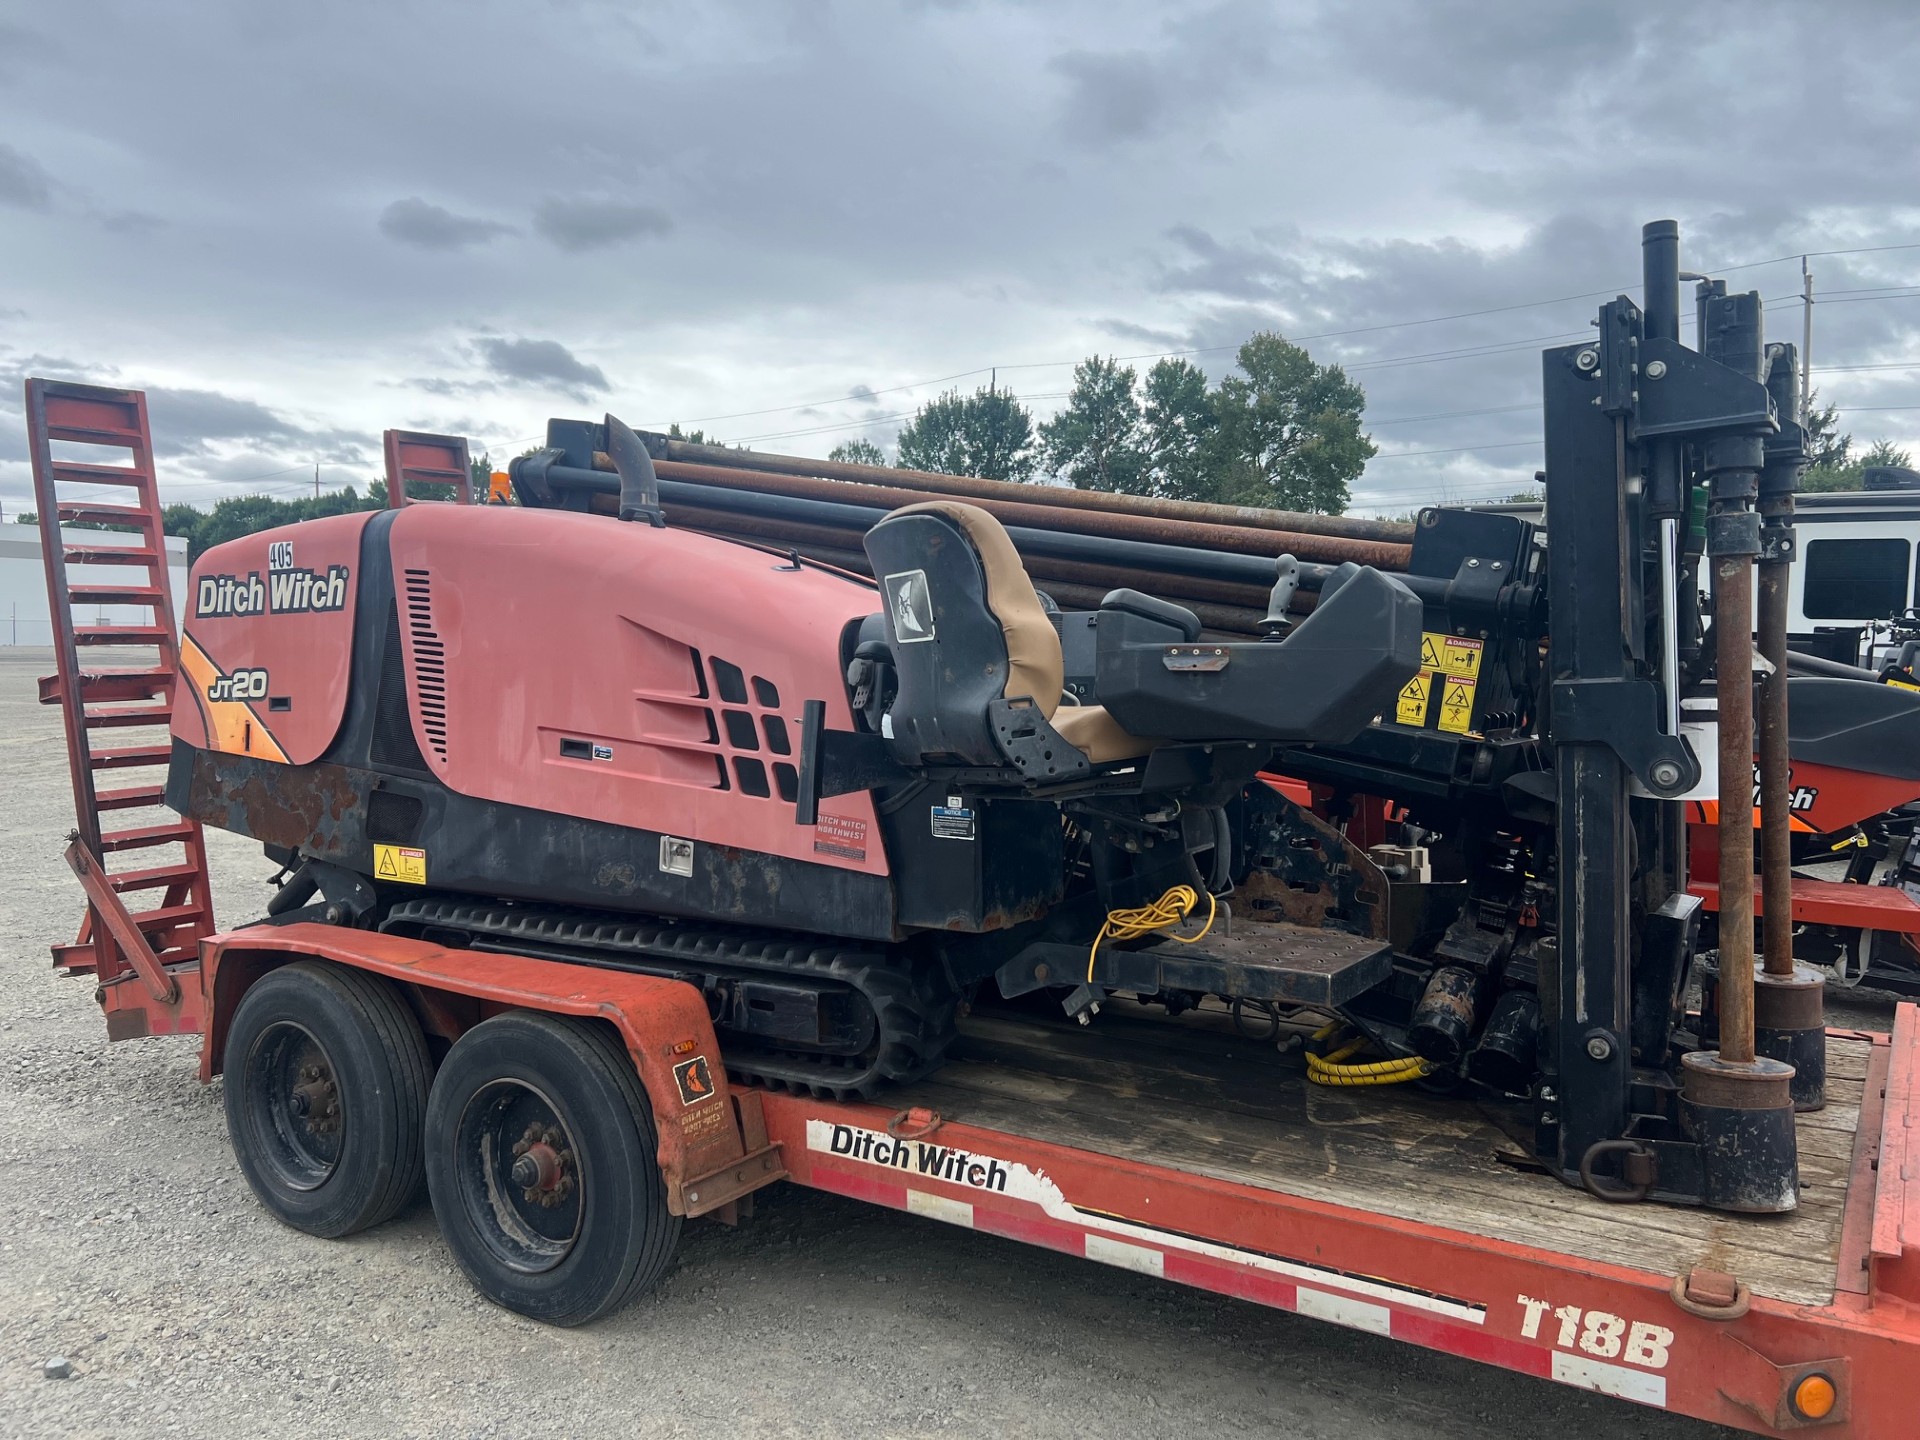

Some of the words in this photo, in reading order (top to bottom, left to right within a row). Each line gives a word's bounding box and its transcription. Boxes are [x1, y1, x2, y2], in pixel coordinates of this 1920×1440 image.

[269, 542, 293, 569] 405
[197, 575, 265, 615] Ditch
[270, 569, 346, 610] Witch
[1453, 639, 1481, 649] DANGER
[208, 670, 268, 699] JT20
[1453, 677, 1475, 686] DANGER
[944, 809, 962, 817] NOTICE
[817, 824, 865, 840] NORTHWEST
[841, 819, 867, 831] WITCH
[830, 1124, 910, 1170] Ditch
[915, 1142, 1008, 1193] Witch
[1516, 1293, 1675, 1369] T18B
